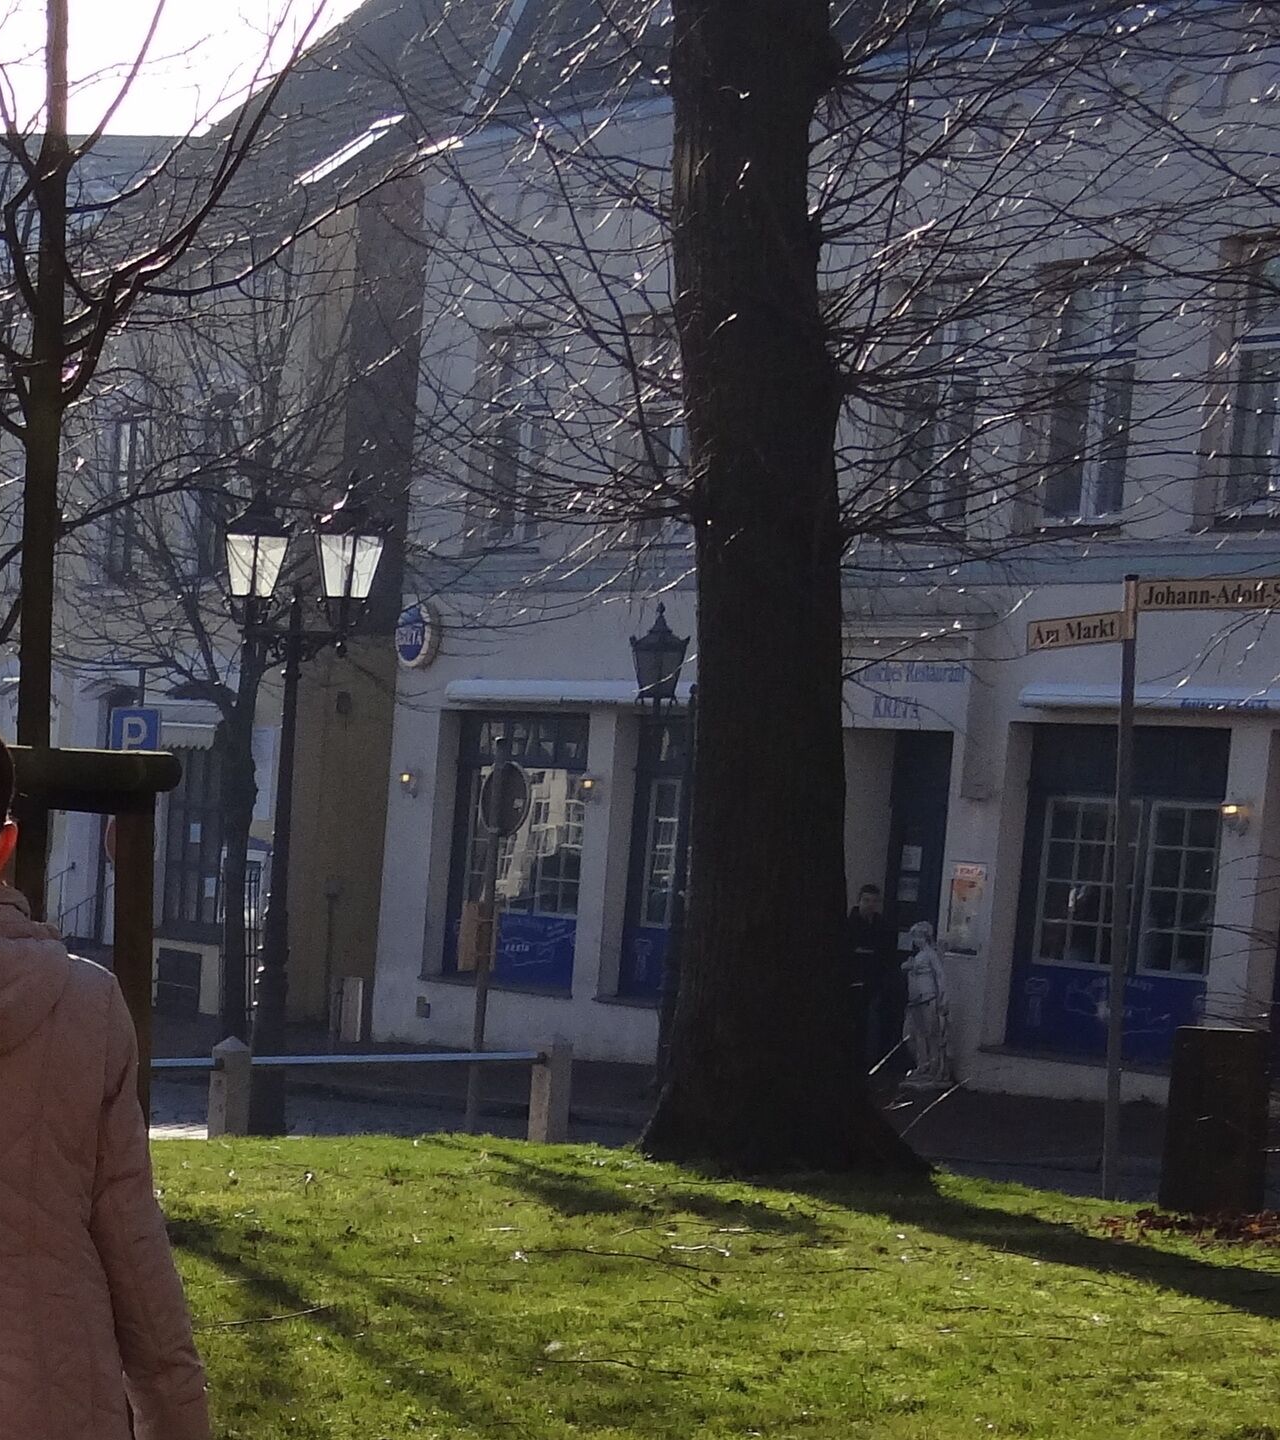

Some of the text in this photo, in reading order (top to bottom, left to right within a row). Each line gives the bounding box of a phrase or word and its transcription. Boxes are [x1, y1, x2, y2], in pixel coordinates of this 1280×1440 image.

[1033, 619, 1116, 646] Am Markt
[122, 717, 147, 751] P
